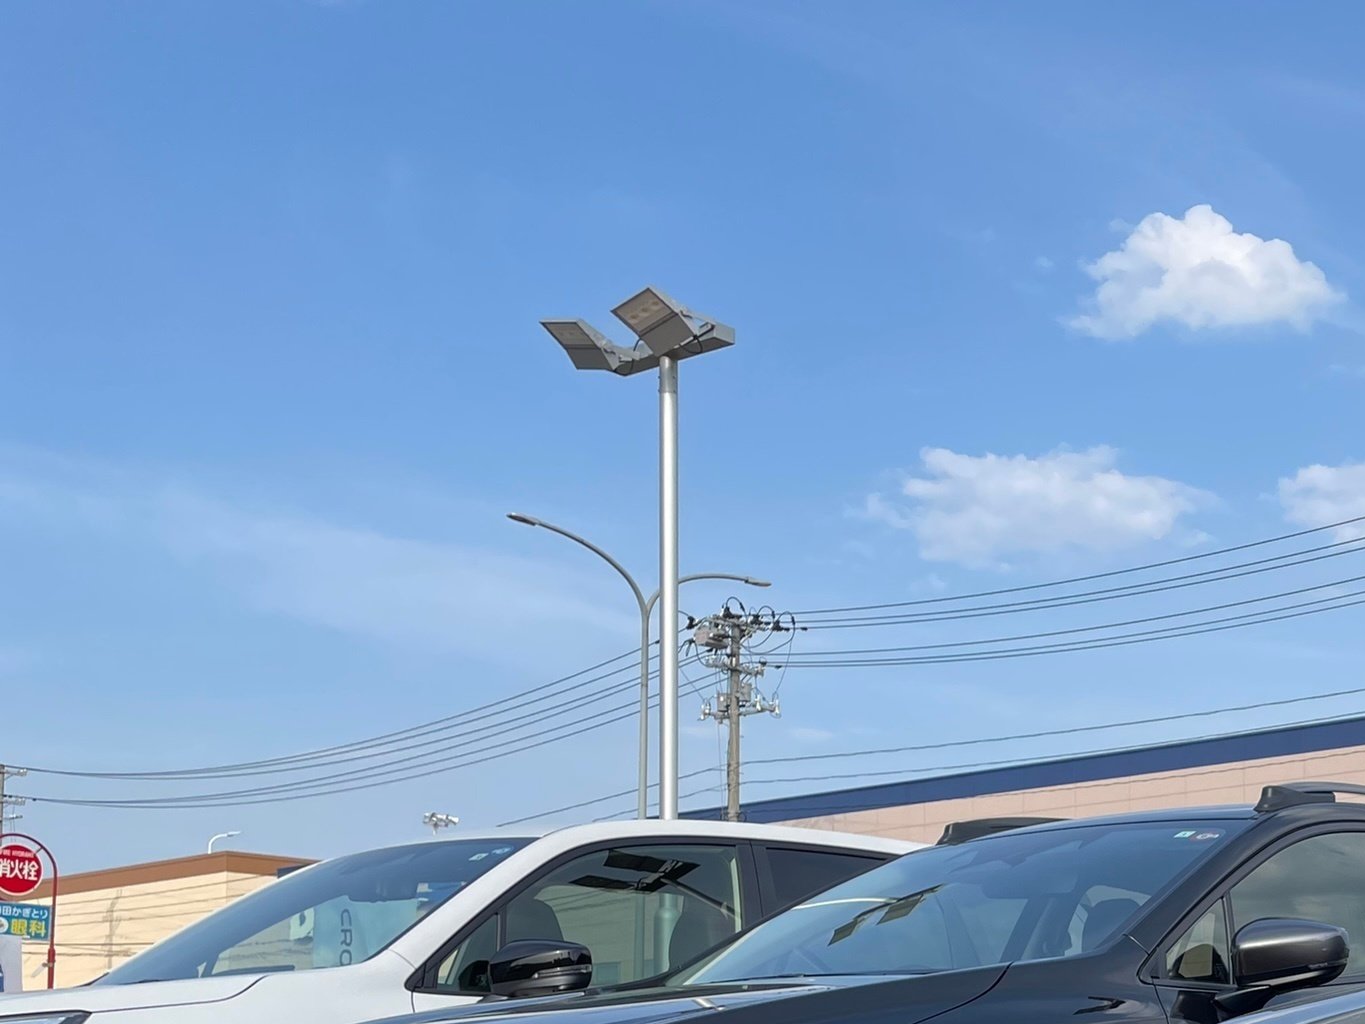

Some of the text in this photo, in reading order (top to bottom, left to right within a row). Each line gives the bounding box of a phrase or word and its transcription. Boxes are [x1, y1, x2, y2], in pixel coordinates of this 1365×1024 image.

[0, 905, 48, 920] 田かぎとり
